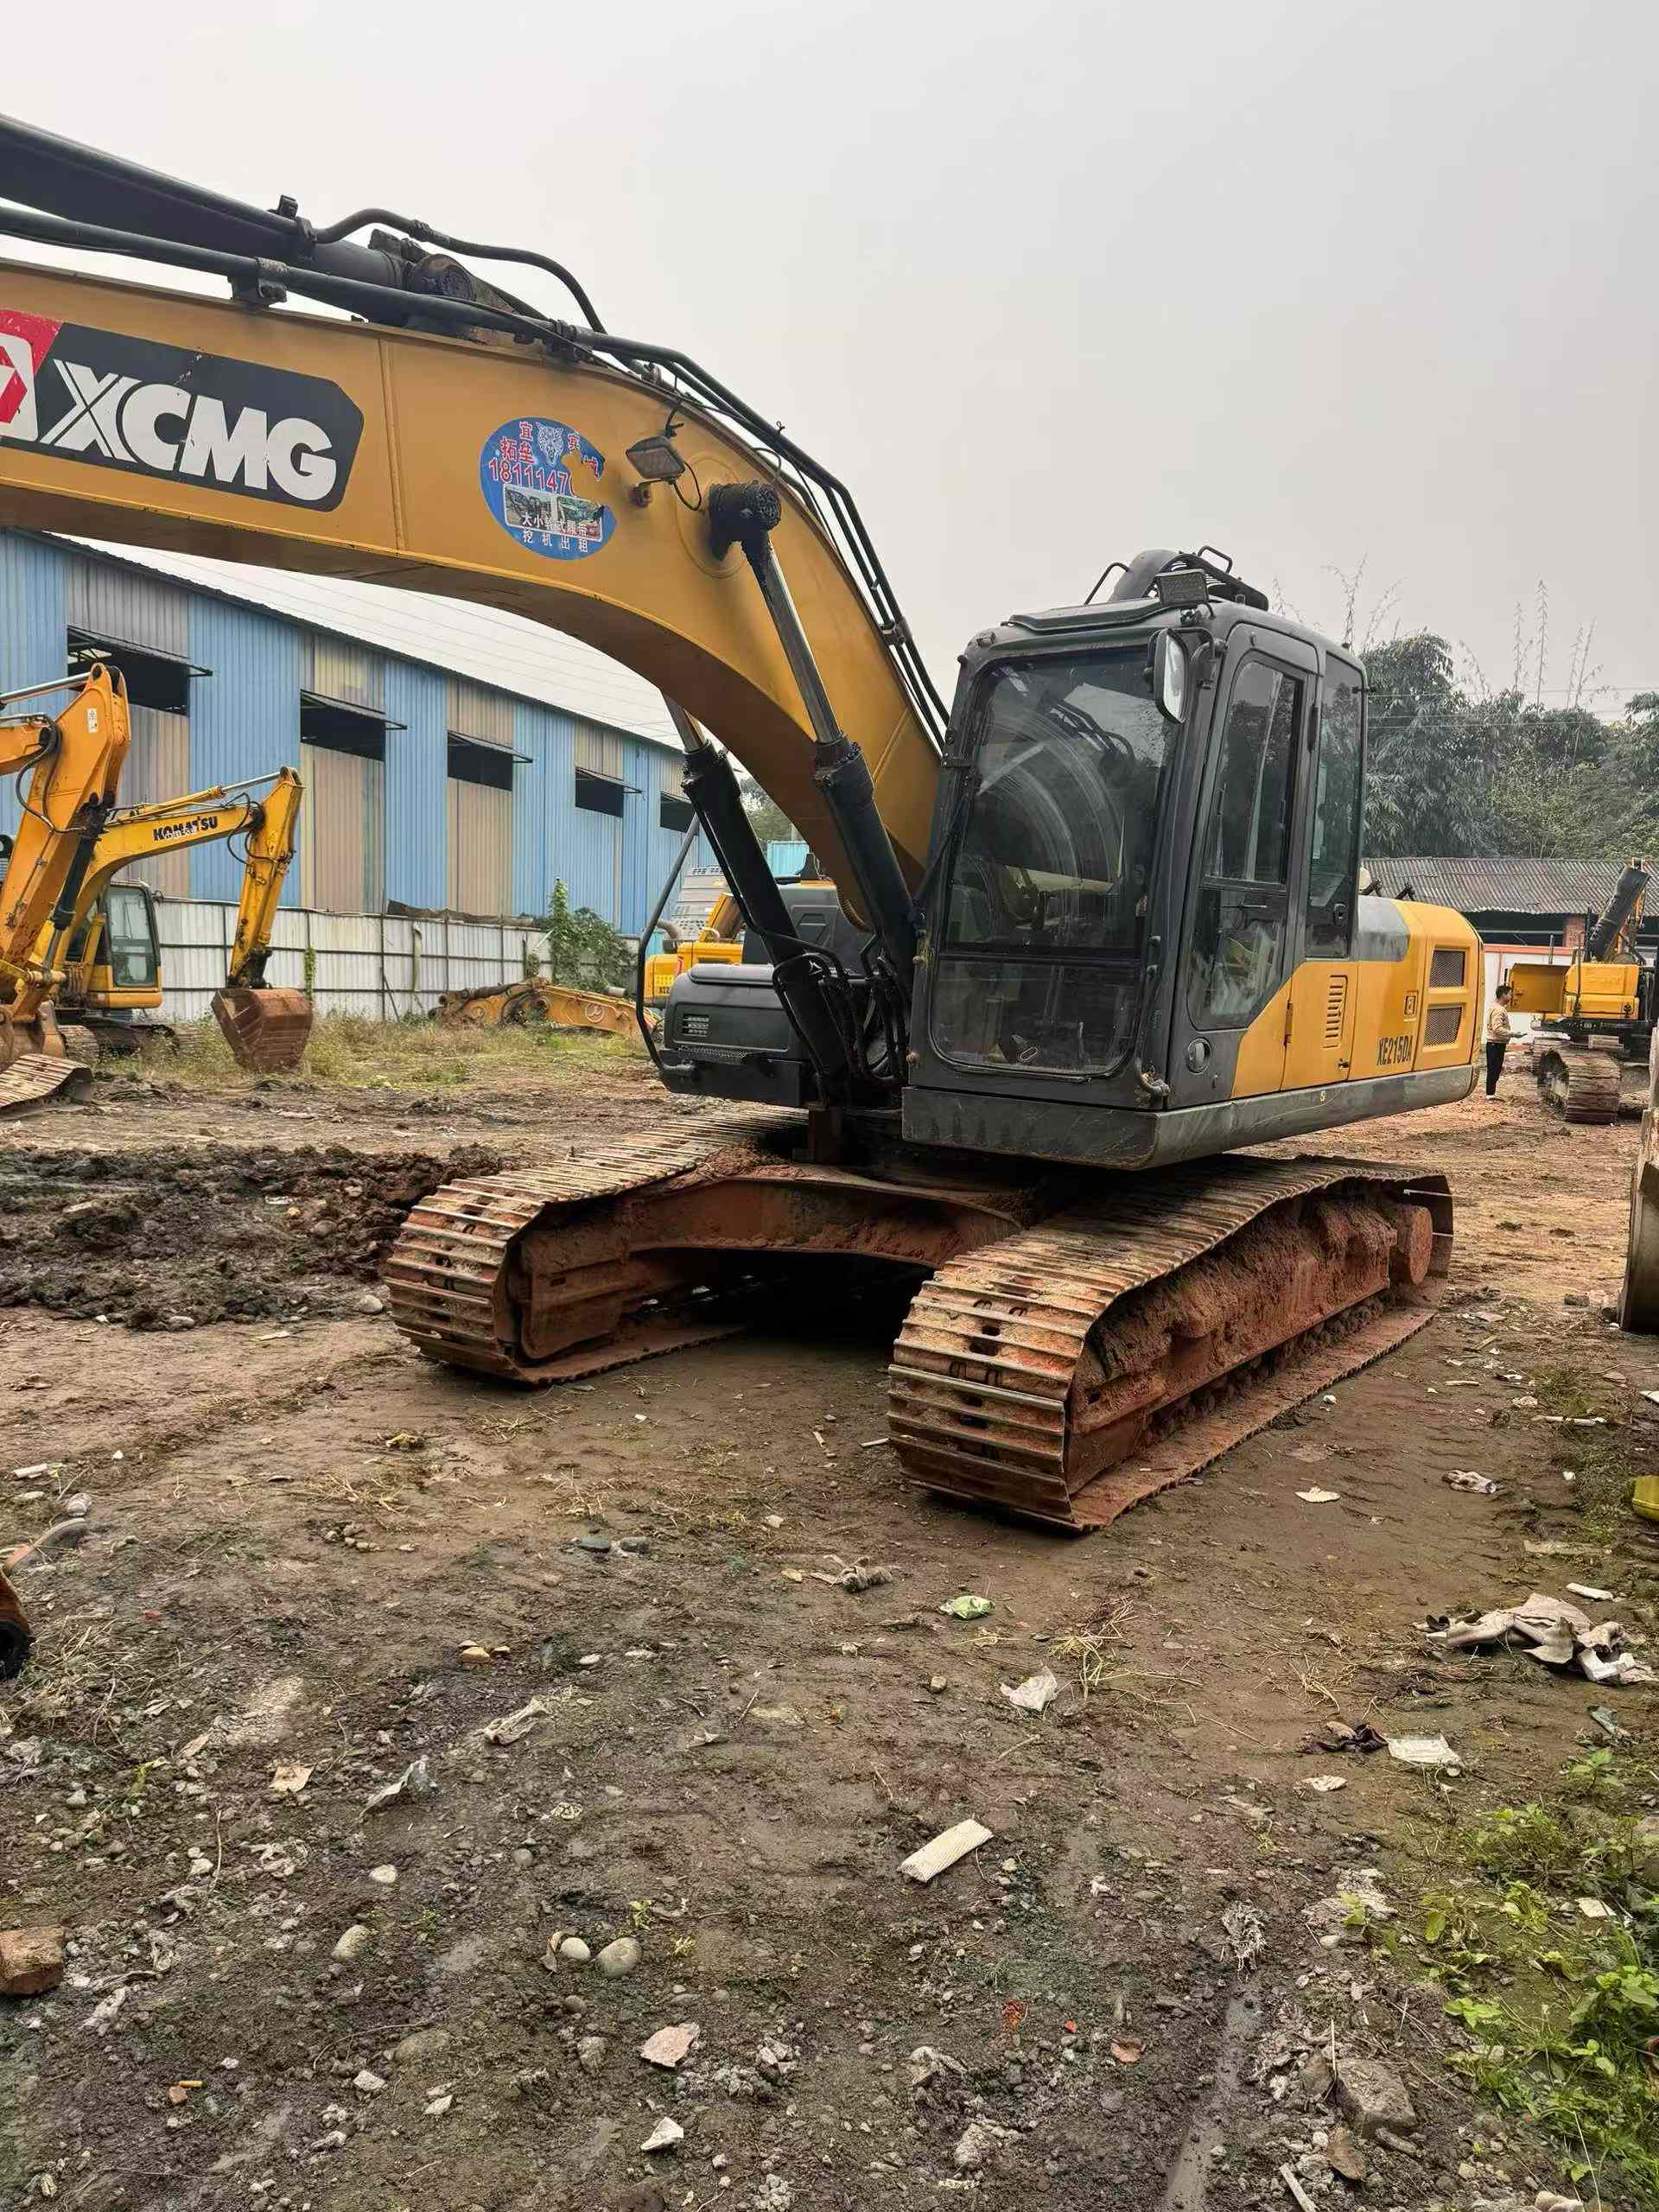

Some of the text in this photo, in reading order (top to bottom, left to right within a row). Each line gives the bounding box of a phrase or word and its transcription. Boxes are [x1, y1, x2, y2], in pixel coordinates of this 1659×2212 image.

[40, 359, 337, 501] XCMG
[489, 457, 576, 498] 1811147
[153, 816, 218, 841] KOMATSU
